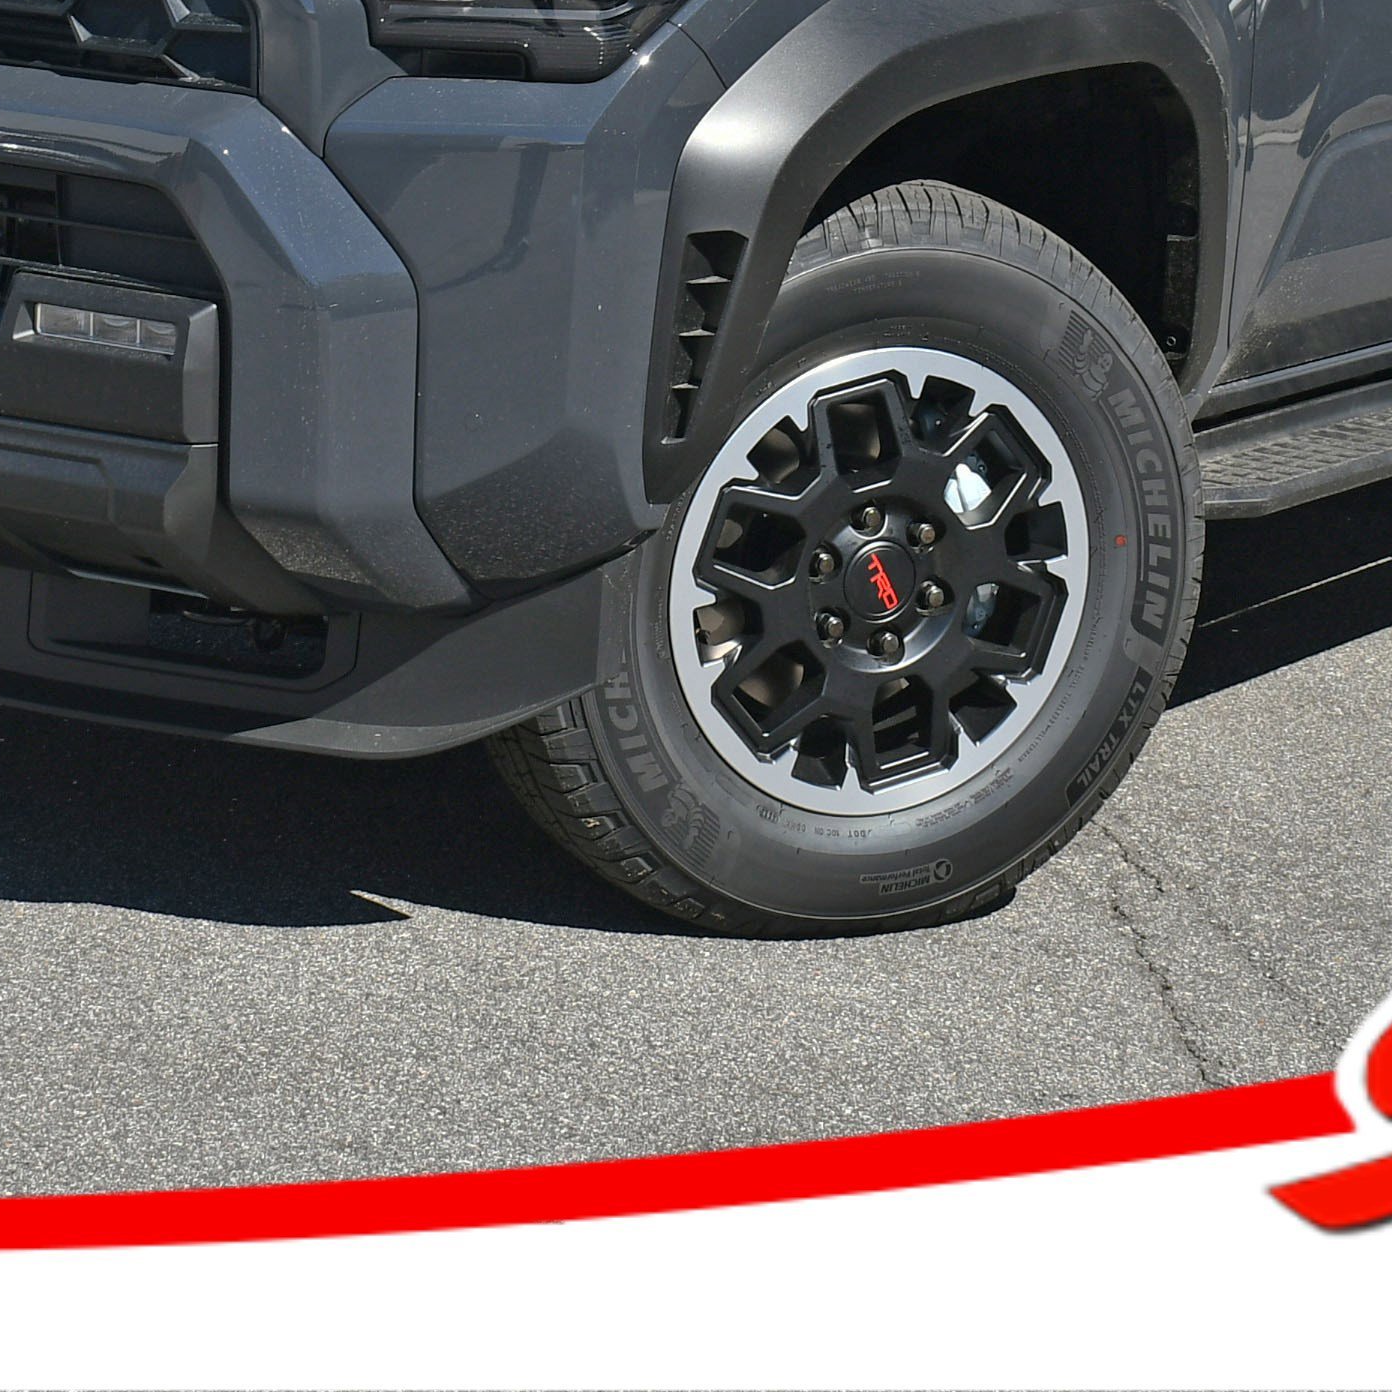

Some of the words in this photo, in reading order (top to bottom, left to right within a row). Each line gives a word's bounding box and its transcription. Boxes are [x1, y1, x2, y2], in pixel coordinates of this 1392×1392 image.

[1108, 389, 1172, 629] MICHELIN
[868, 552, 899, 609] TRD
[604, 646, 669, 793] MICH
[1118, 681, 1146, 728] LTX
[1076, 731, 1120, 787] TRAIL
[880, 875, 930, 894] MICHELIN
